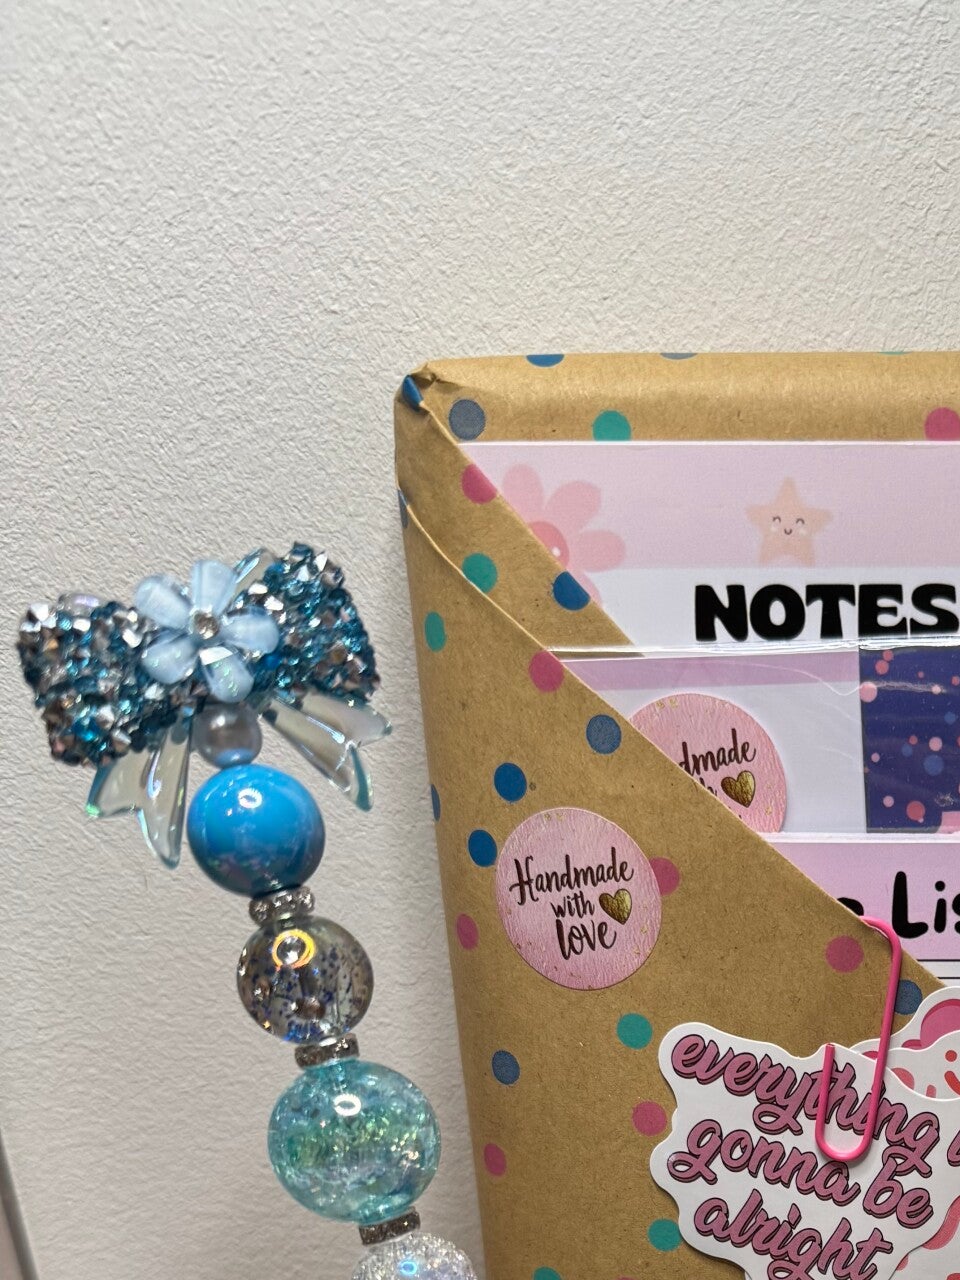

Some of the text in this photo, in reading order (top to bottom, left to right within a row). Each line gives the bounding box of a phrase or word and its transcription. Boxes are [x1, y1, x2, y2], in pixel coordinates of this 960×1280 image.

[694, 583, 960, 642] NOTES
[679, 728, 756, 777] dmade
[509, 846, 635, 906] Handmade
[550, 891, 595, 919] with
[555, 919, 617, 961] love
[667, 1119, 861, 1208] gonna
[862, 1157, 934, 1230] be
